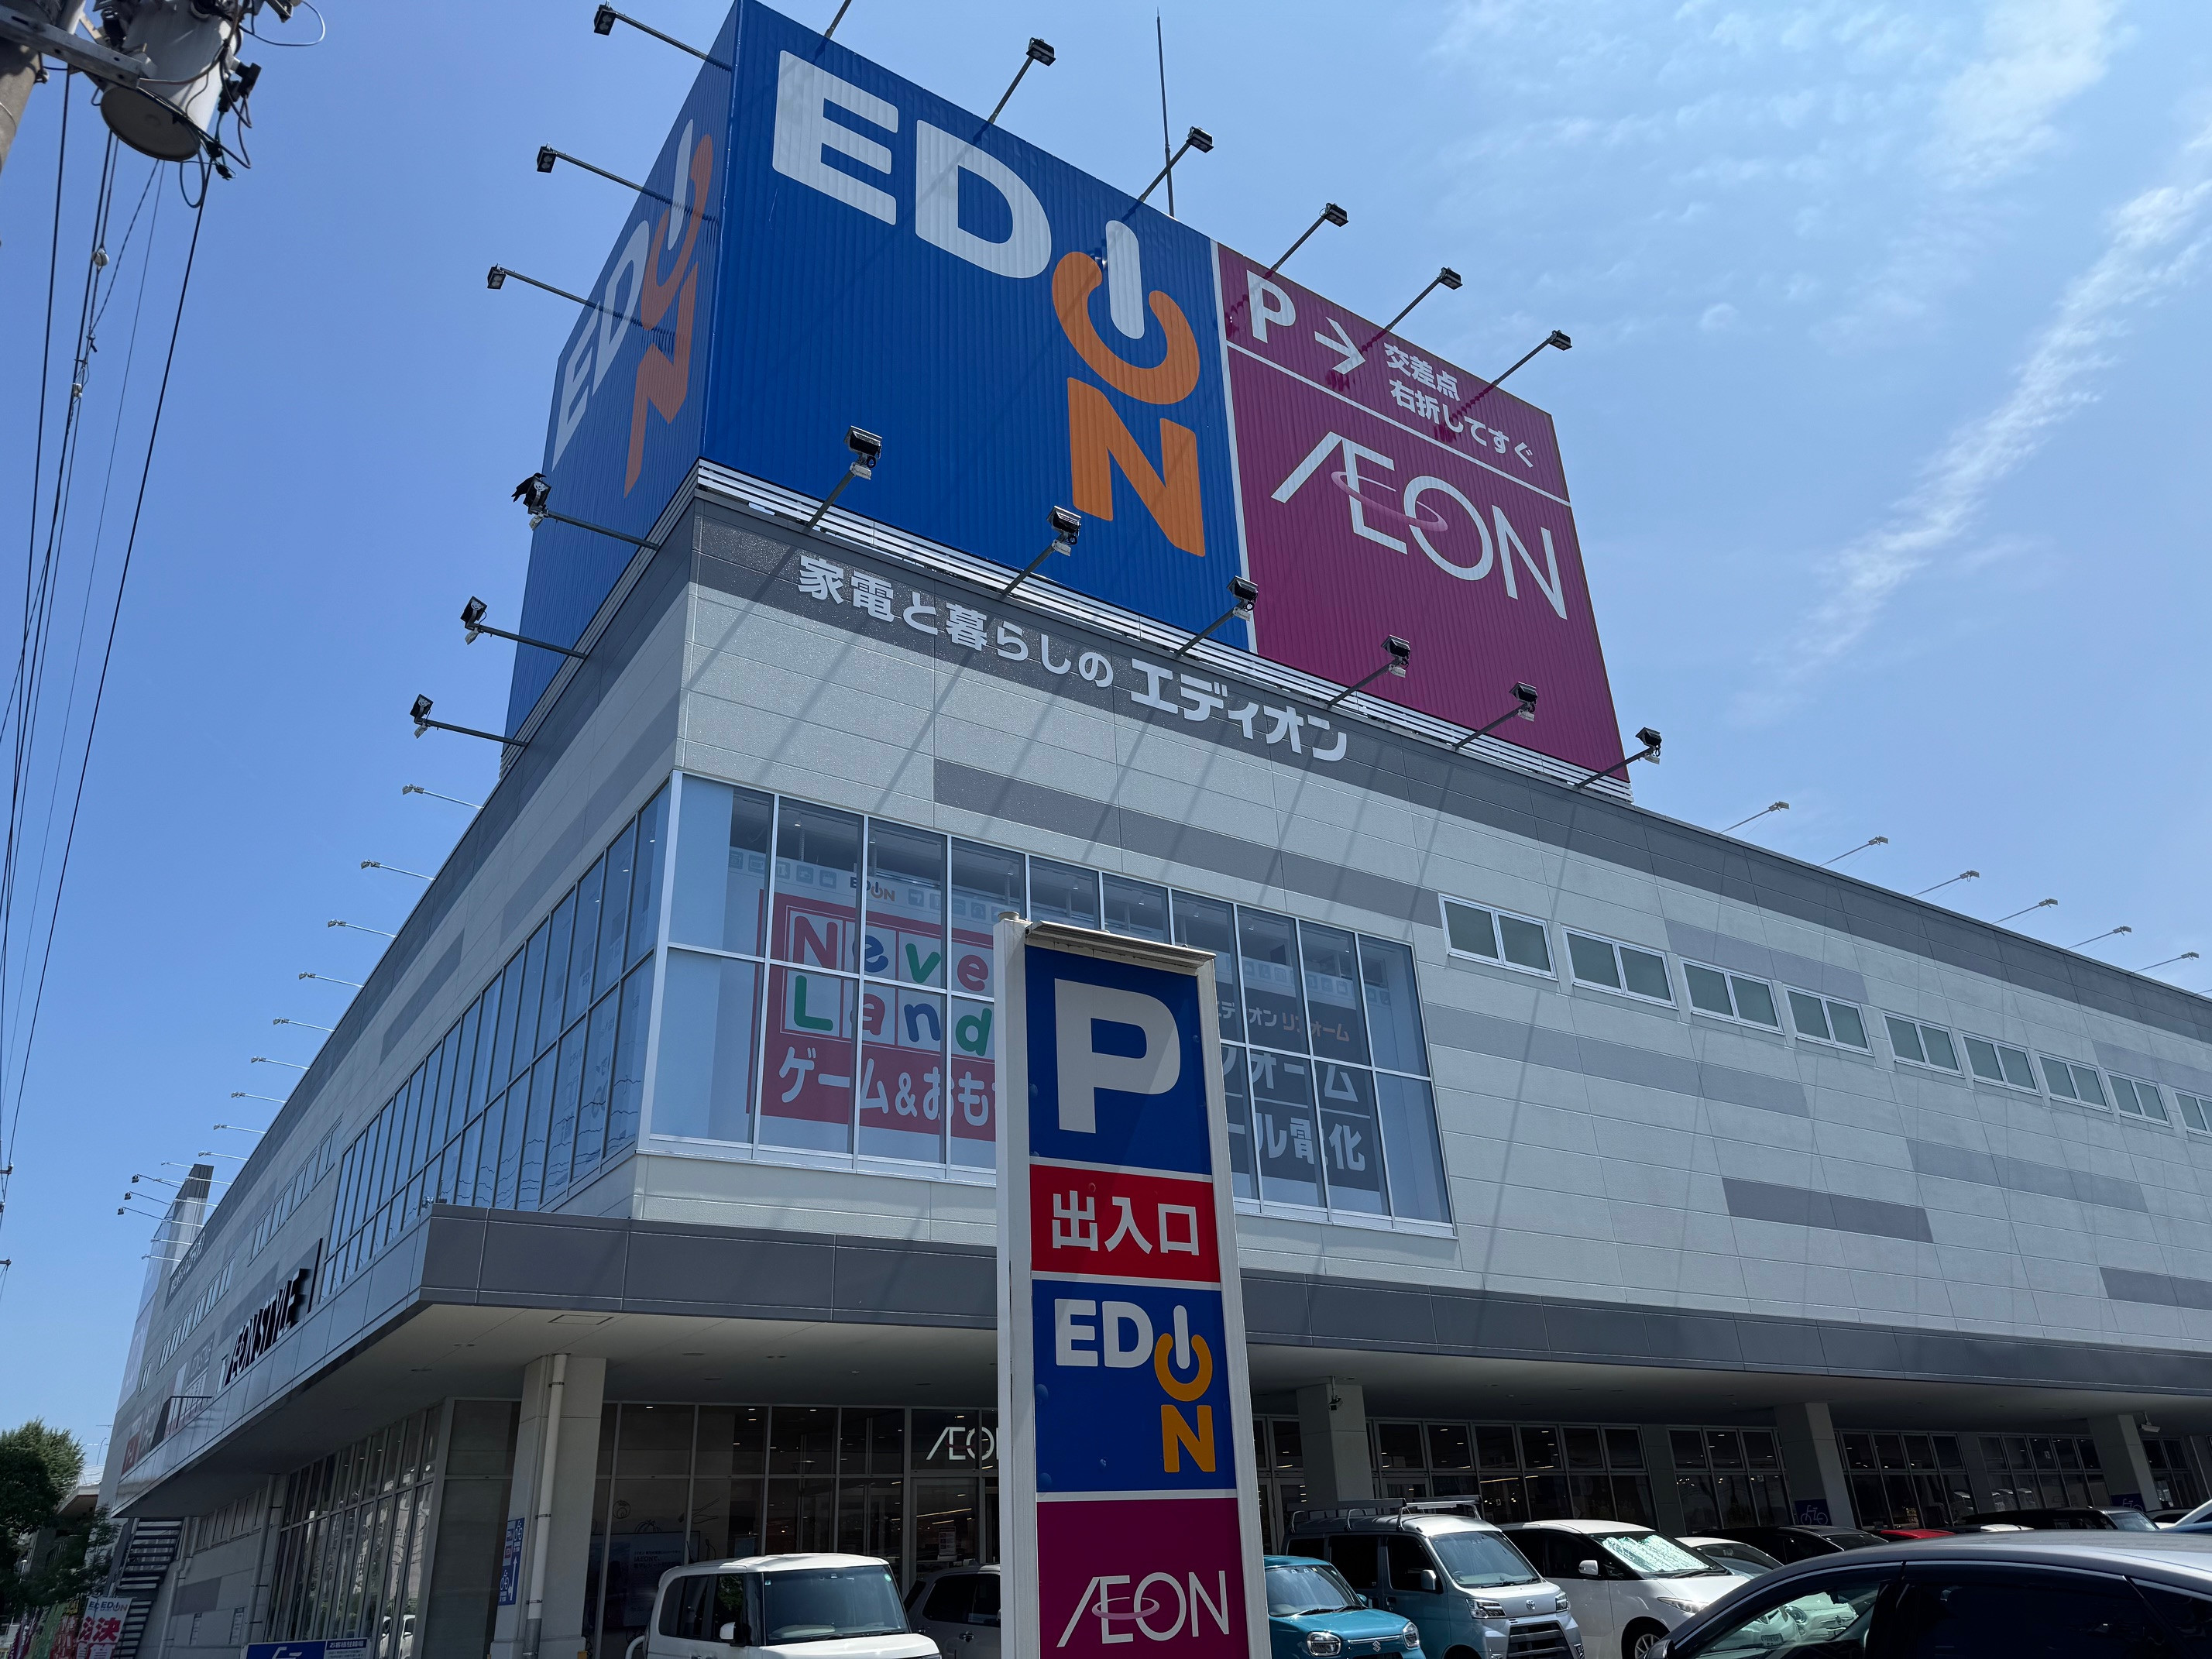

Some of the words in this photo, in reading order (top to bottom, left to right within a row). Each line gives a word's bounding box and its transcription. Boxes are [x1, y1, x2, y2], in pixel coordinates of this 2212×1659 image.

[773, 50, 1205, 557] EDION
[1247, 270, 1297, 343] P
[1383, 341, 1462, 402] 交差点
[1389, 379, 1535, 469] 右折してすぐ
[797, 555, 1115, 688] 家電と暮らしの
[1130, 657, 1348, 762] エディオン
[793, 915, 989, 991] Neve
[778, 1046, 994, 1126] ゲーム&おも
[1054, 977, 1181, 1134] P
[1052, 1190, 1200, 1256] 出入口
[1054, 1298, 1217, 1473] EDION
